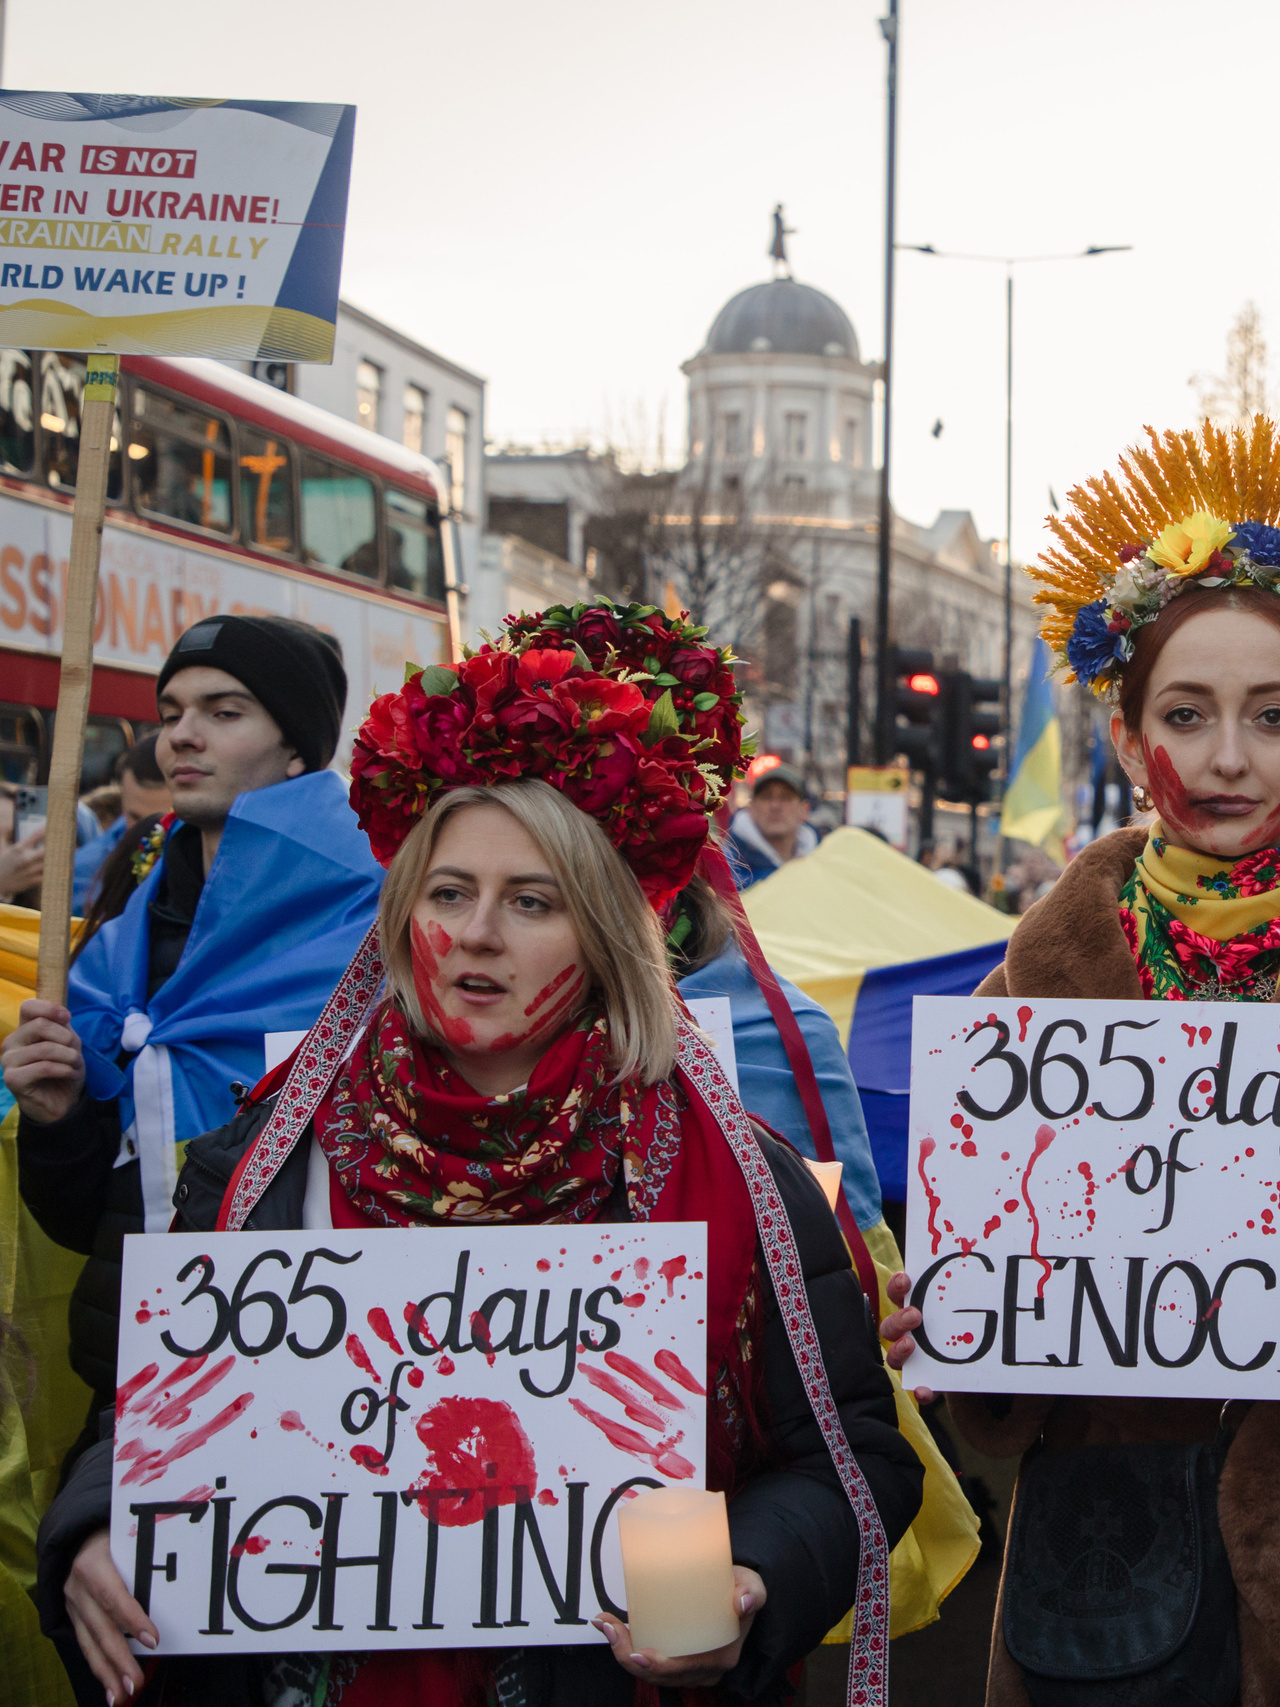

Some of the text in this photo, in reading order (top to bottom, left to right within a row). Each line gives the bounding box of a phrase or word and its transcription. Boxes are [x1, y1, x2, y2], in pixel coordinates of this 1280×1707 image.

[0, 141, 195, 177] AR IS NOT
[0, 183, 280, 225] ER IN UKRAINE!
[0, 262, 64, 290] RLD
[73, 266, 176, 296] WAKE
[183, 272, 229, 298] UP
[161, 232, 270, 260] RALLY
[956, 1018, 1161, 1121] 365
[1125, 1128, 1198, 1234] of
[160, 1247, 625, 1398] 365 days
[340, 1360, 411, 1468] of
